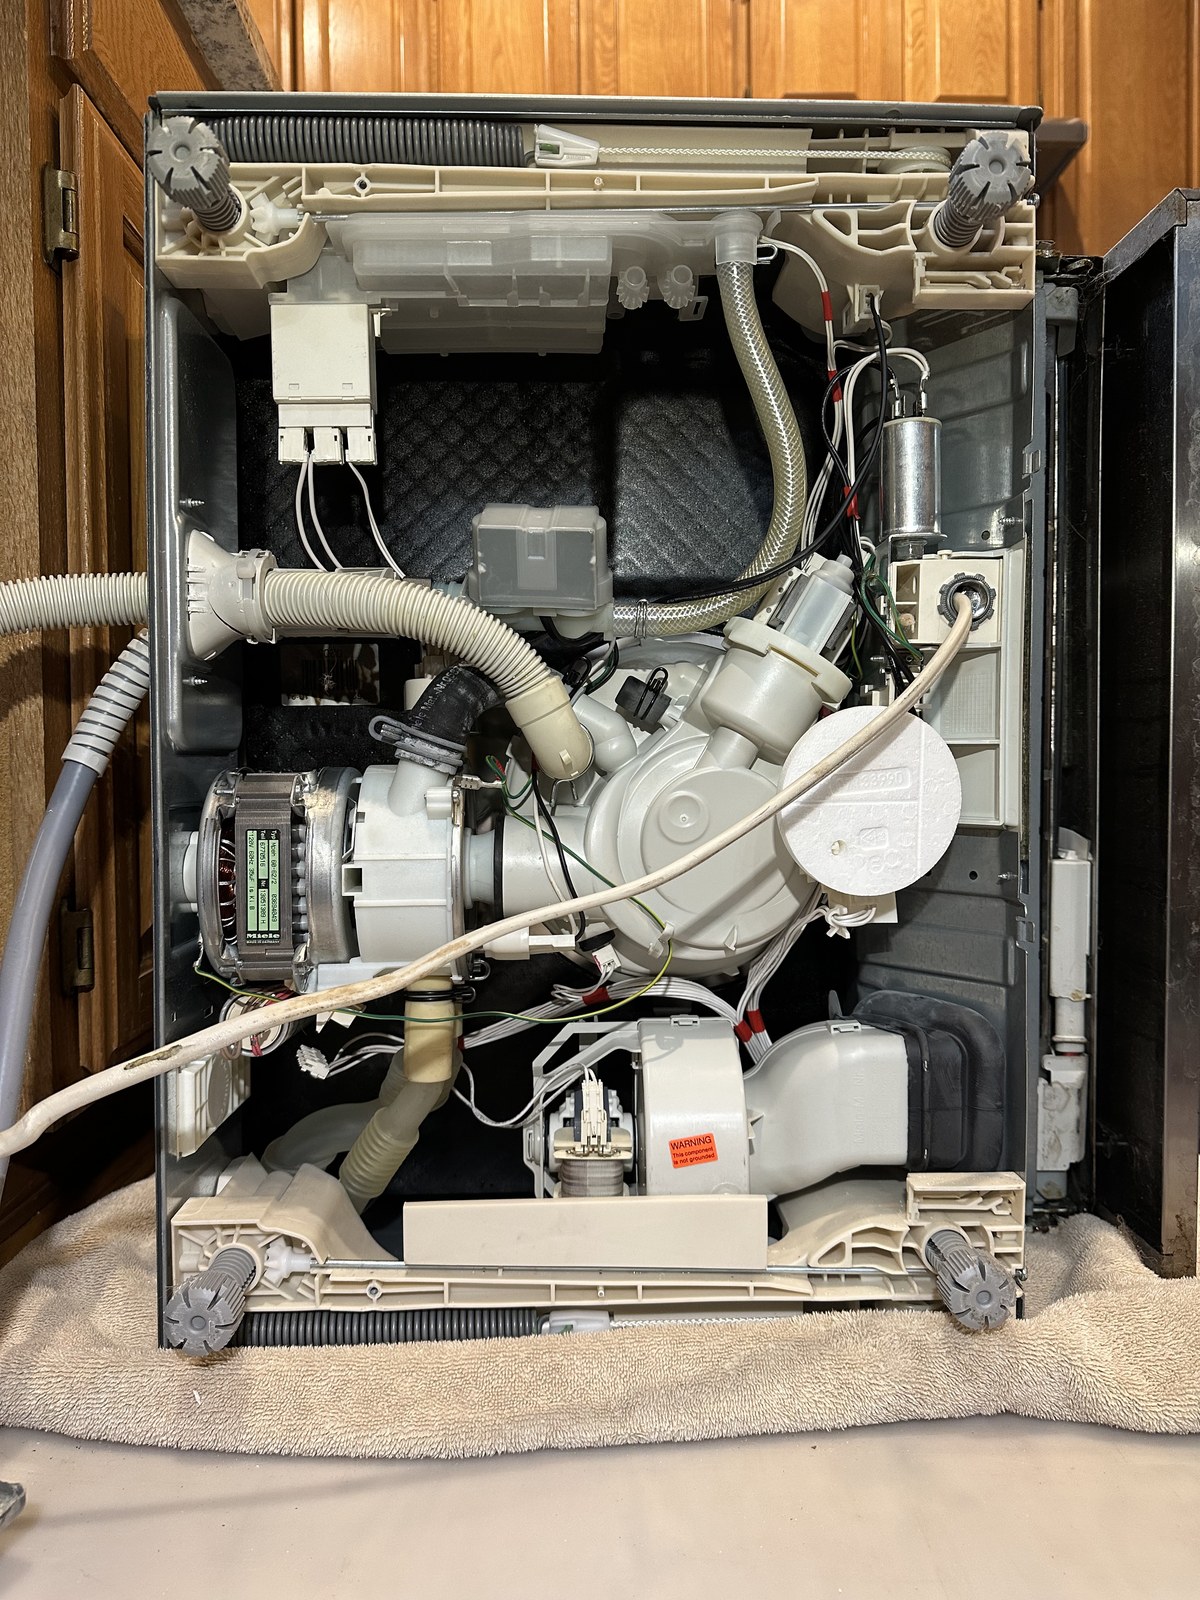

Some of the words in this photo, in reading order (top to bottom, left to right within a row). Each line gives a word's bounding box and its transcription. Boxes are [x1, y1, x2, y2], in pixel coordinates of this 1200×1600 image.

[670, 1136, 712, 1150] WARNING
[685, 1146, 714, 1157] component
[689, 1153, 715, 1163] grounded
